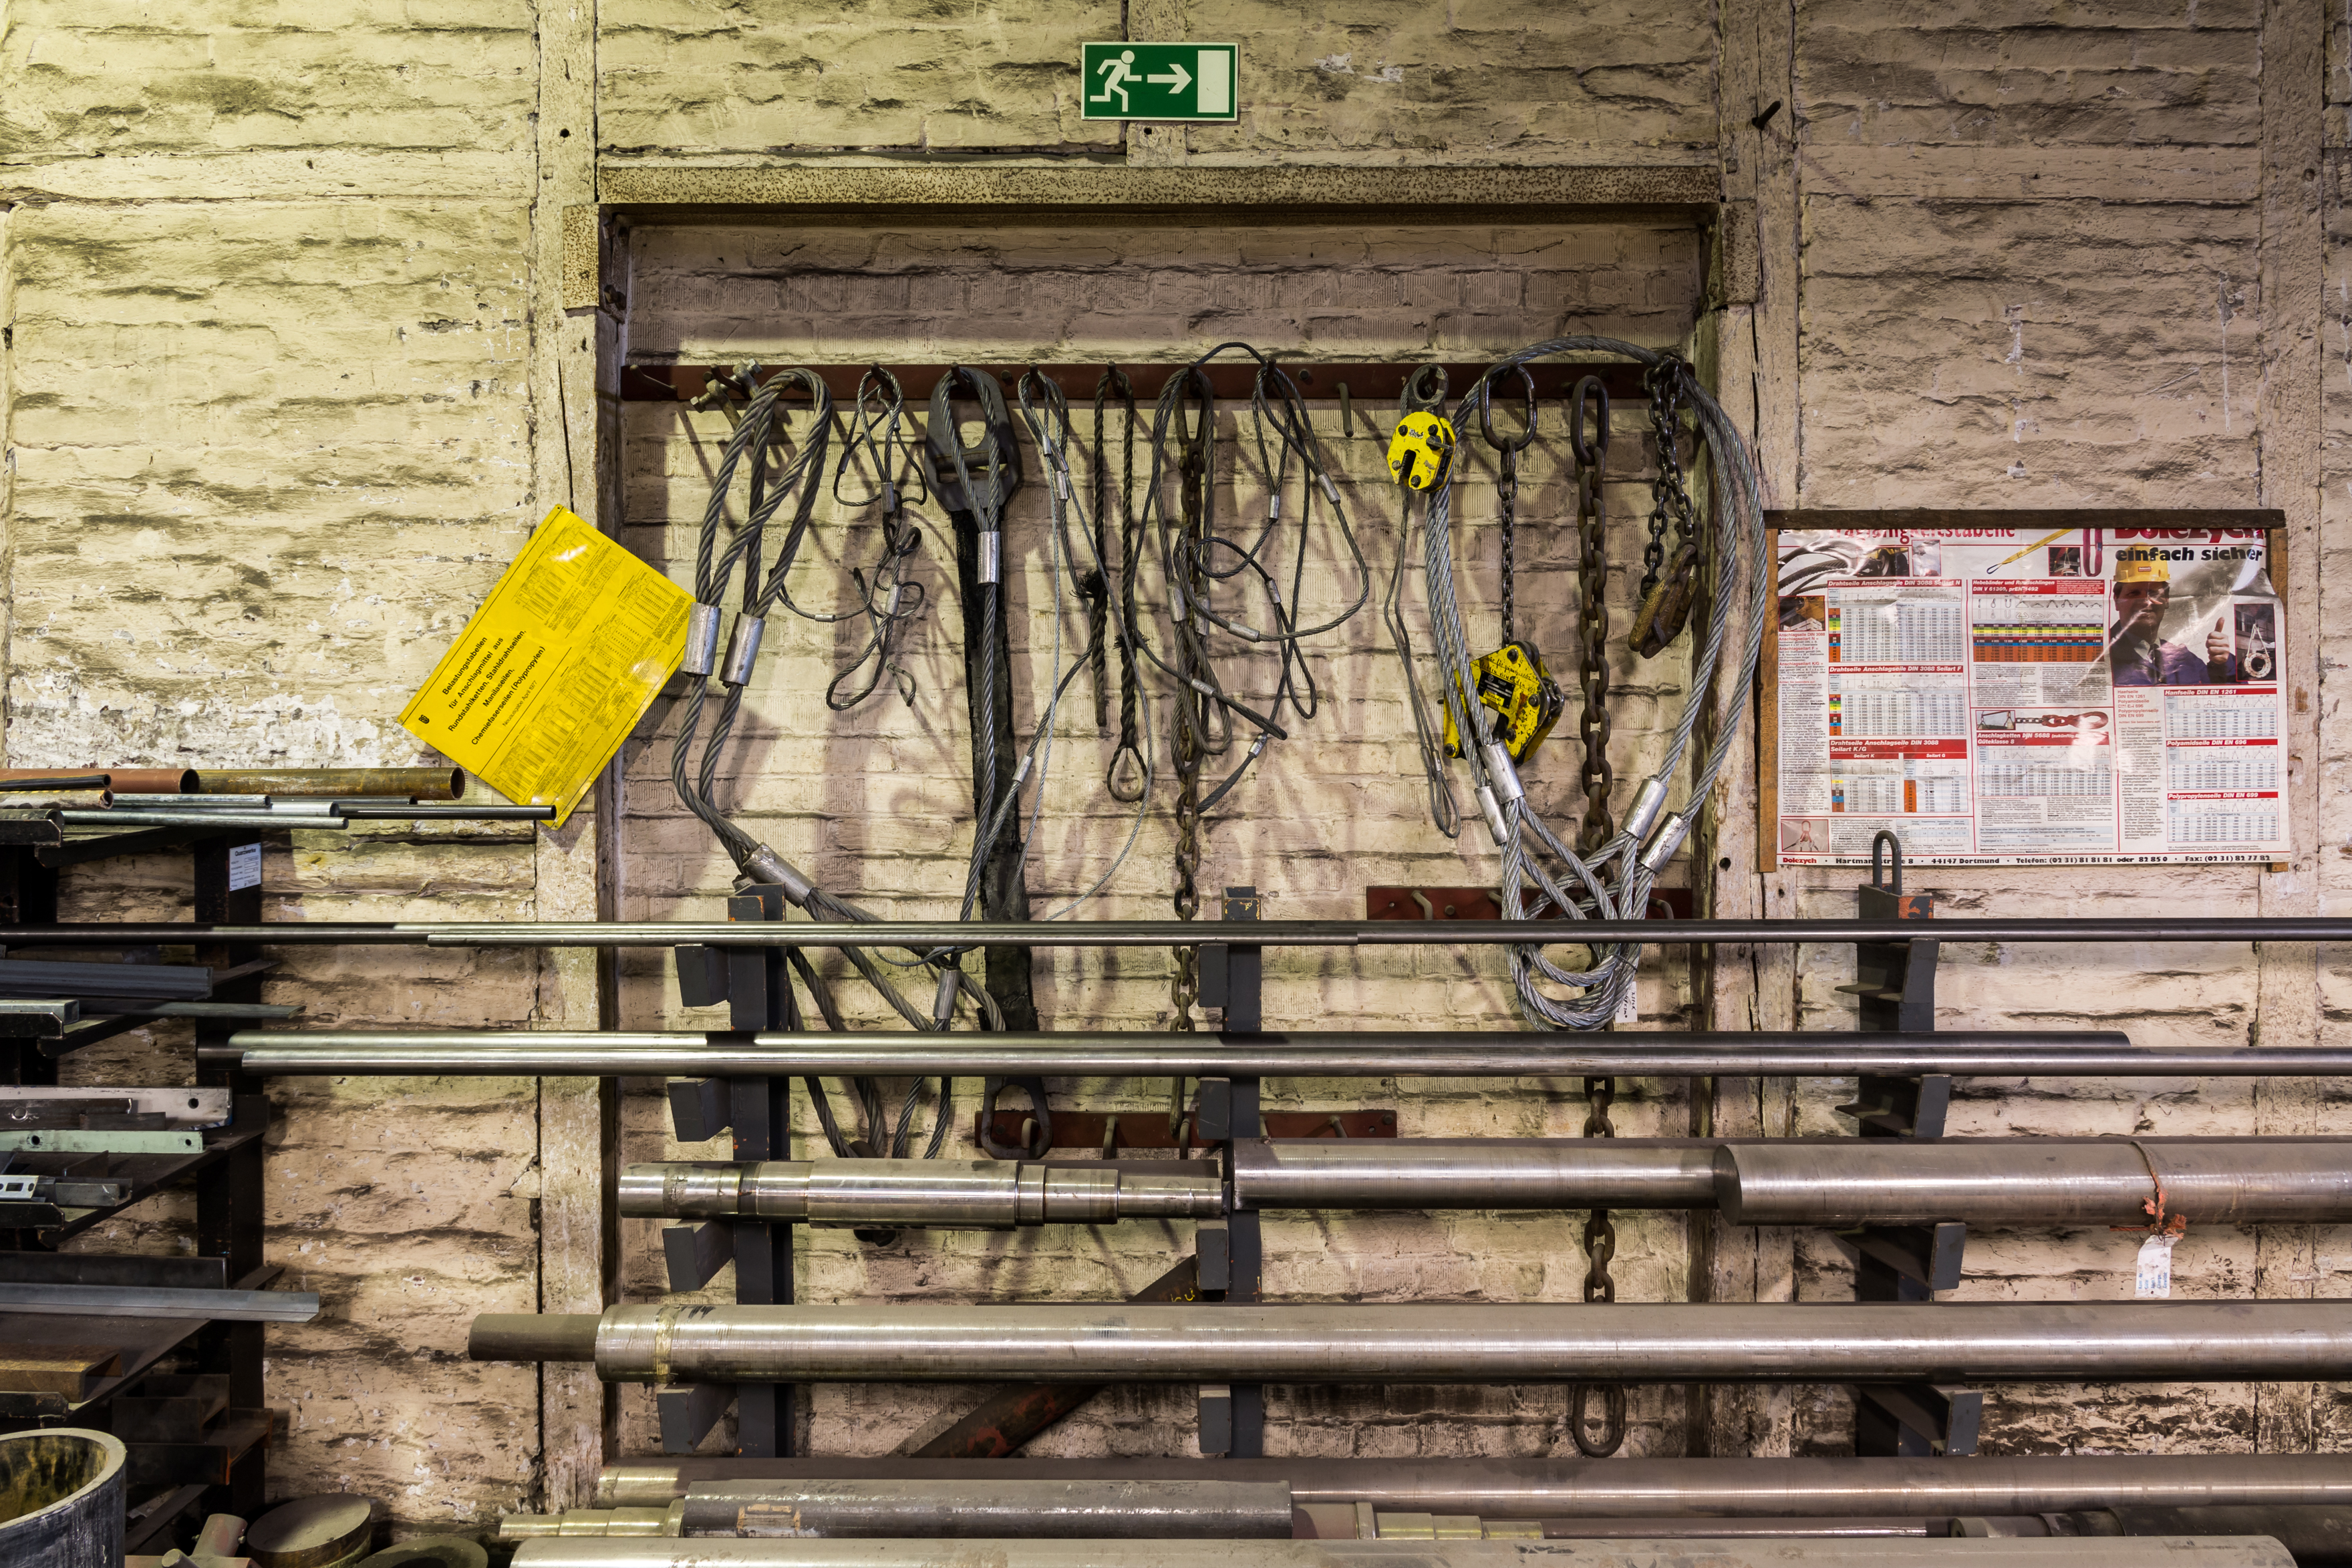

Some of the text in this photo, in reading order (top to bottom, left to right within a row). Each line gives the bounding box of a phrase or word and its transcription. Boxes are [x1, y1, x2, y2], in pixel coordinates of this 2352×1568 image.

[2115, 546, 2263, 561] einfach sicher
[442, 637, 488, 695] Belastungstabellen
[448, 637, 504, 709] für Anschlagmittel aus
[448, 681, 490, 732] Rundstahlketten,
[486, 631, 527, 680] Stahldrahtseilen,
[482, 669, 515, 707] Manilaseilen,
[471, 690, 514, 745] Chemiefaserseilen
[510, 646, 546, 691] (Polypropylen)
[502, 680, 537, 726] Neuausgabe April 1977
